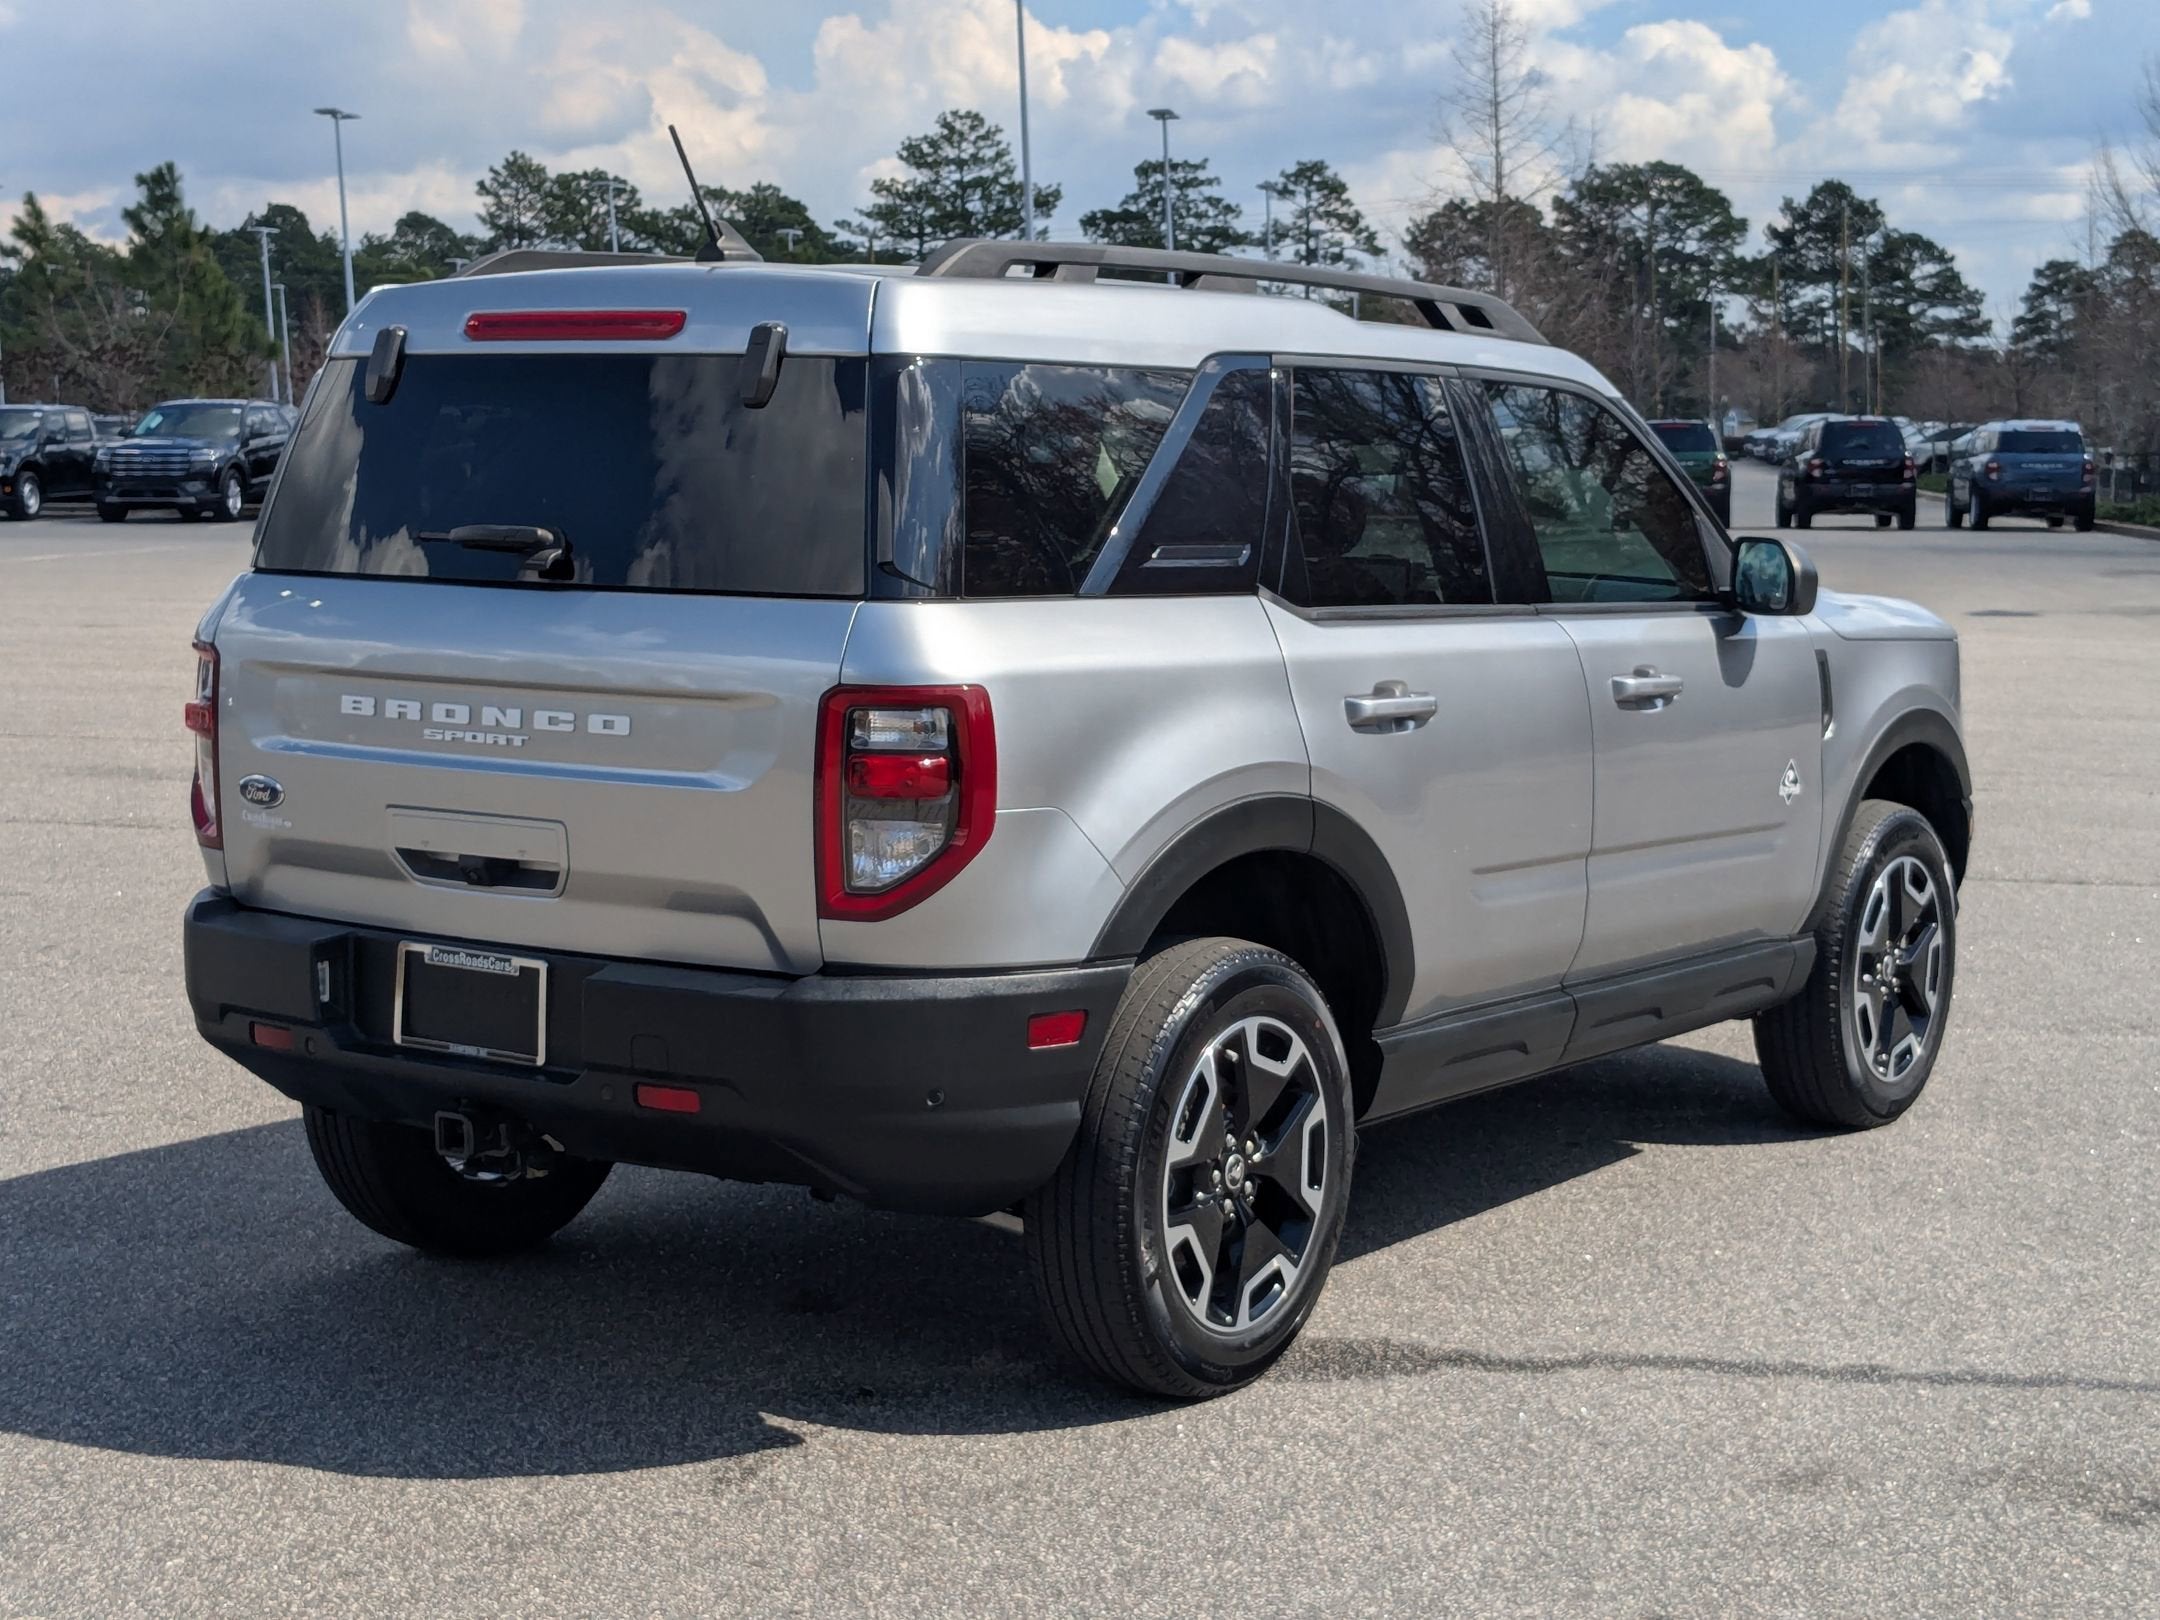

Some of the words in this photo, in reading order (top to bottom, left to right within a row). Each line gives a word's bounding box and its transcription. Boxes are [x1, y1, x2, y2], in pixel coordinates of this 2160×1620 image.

[341, 695, 631, 735] BRONCO
[423, 728, 530, 746] SPORT
[246, 782, 271, 802] Ford
